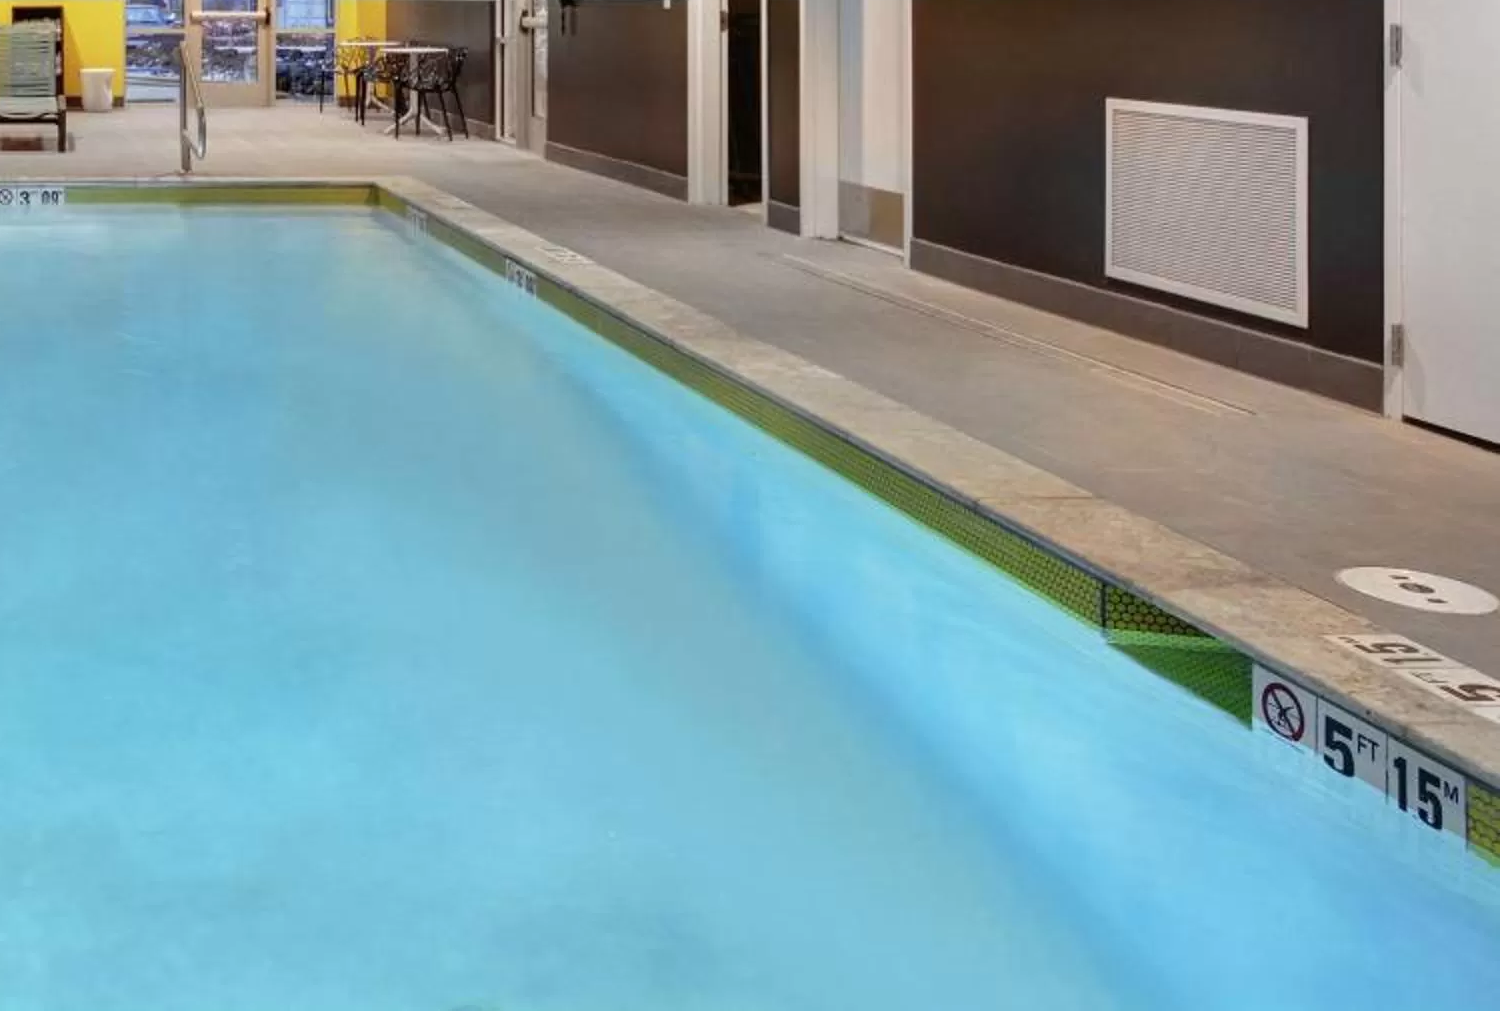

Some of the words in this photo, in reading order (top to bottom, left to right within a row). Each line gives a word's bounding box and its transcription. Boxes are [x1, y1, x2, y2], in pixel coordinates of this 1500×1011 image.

[1323, 715, 1355, 778] 5
[1357, 732, 1380, 763] FT
[1444, 781, 1459, 805] M
